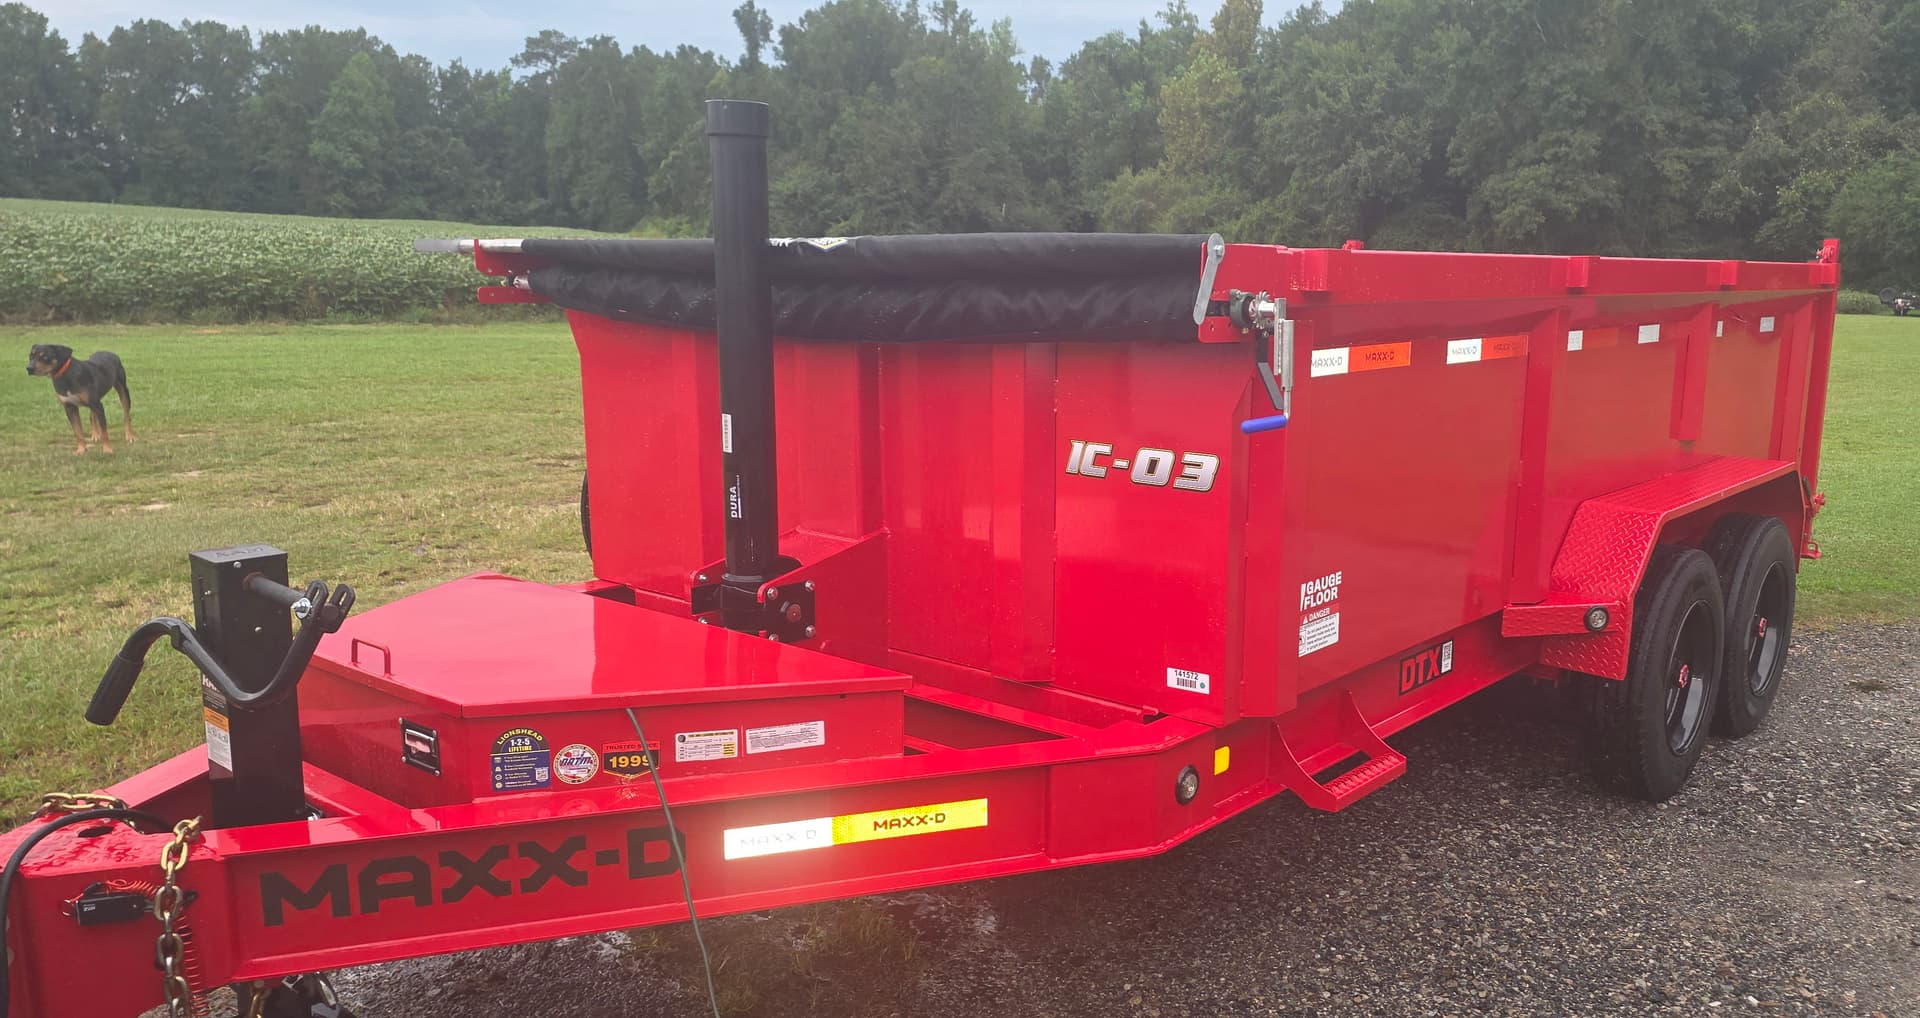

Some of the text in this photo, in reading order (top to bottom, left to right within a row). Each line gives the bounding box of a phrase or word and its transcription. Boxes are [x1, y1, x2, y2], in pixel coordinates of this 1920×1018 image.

[1365, 350, 1395, 362] MAXX-D
[730, 486, 738, 518] DURA
[1306, 571, 1342, 595] GAUGE
[1304, 587, 1338, 610] FLOOR
[1309, 608, 1330, 621] DANGER
[1174, 670, 1199, 680] 141572
[1401, 647, 1440, 692] DTX
[497, 729, 543, 745] LIONSHEAD
[873, 812, 946, 832] MAXX-D
[740, 829, 817, 848] MAXXD
[260, 825, 686, 927] MAXX-D
